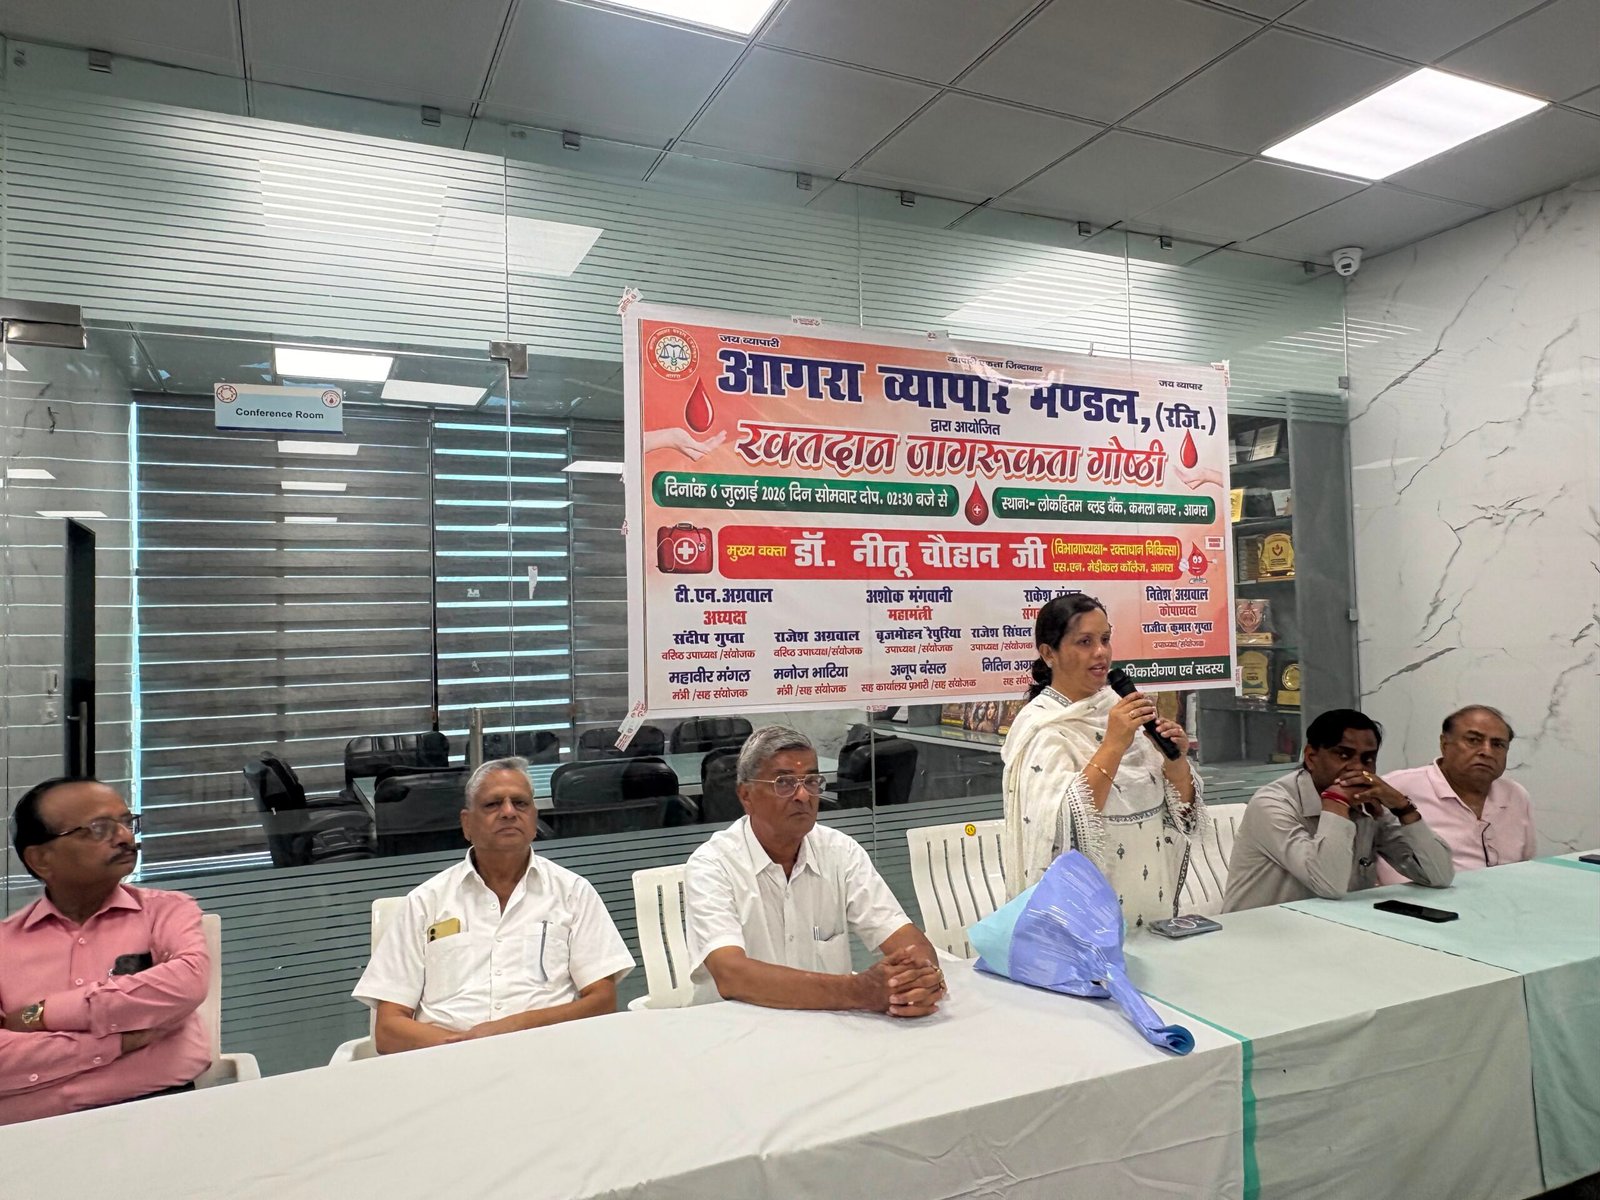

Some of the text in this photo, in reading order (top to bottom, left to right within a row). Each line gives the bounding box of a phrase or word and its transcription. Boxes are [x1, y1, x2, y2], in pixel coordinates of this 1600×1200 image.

[719, 335, 780, 348] जय व्यापारी
[1158, 379, 1175, 388] जय
[718, 350, 865, 403] आगरा
[878, 366, 1011, 415] व्यापार
[1156, 402, 1217, 436] (रजि.)
[235, 407, 324, 419] Conference Room
[930, 418, 1000, 435] द्वारा आयोजित
[737, 422, 1167, 484] रक्तदान जागरूकता गोष्ठी
[664, 475, 948, 507] दिनांक 6 जुलाई 2026 दिन सोमवार दोप. 02:30 बजे से
[1038, 494, 1082, 514] लोकहितम
[1129, 501, 1155, 516] कमला
[1183, 504, 1208, 518] आगरा
[726, 531, 1048, 578] मुख्य वक्ता डॉ. नीतू चौहान जी
[866, 585, 953, 603] अशोक मंगवानी
[1023, 586, 1052, 603] राकेश
[1146, 586, 1208, 602] नितेश अग्रवाल
[703, 610, 748, 625] अध्यक्ष
[887, 605, 933, 621] महामंत्री
[774, 629, 860, 643] राजेश अग्रवाल
[875, 627, 923, 644] बृजमोहन
[970, 626, 999, 639] राजेश
[1142, 621, 1212, 635] राजीव कुमार गुप्ता
[673, 629, 745, 648] संदीप गुप्ता
[773, 662, 849, 680] मनोज भाटिया
[890, 663, 917, 680] अनूप
[982, 657, 1011, 672] नितिन
[1180, 661, 1194, 676] एवं
[1195, 663, 1224, 675] सदस्य
[669, 666, 751, 684] महावीर मंगल
[713, 687, 748, 699] संयोजक
[815, 683, 847, 695] संयोजक
[861, 684, 874, 693] सह
[948, 678, 977, 689] संयोजक
